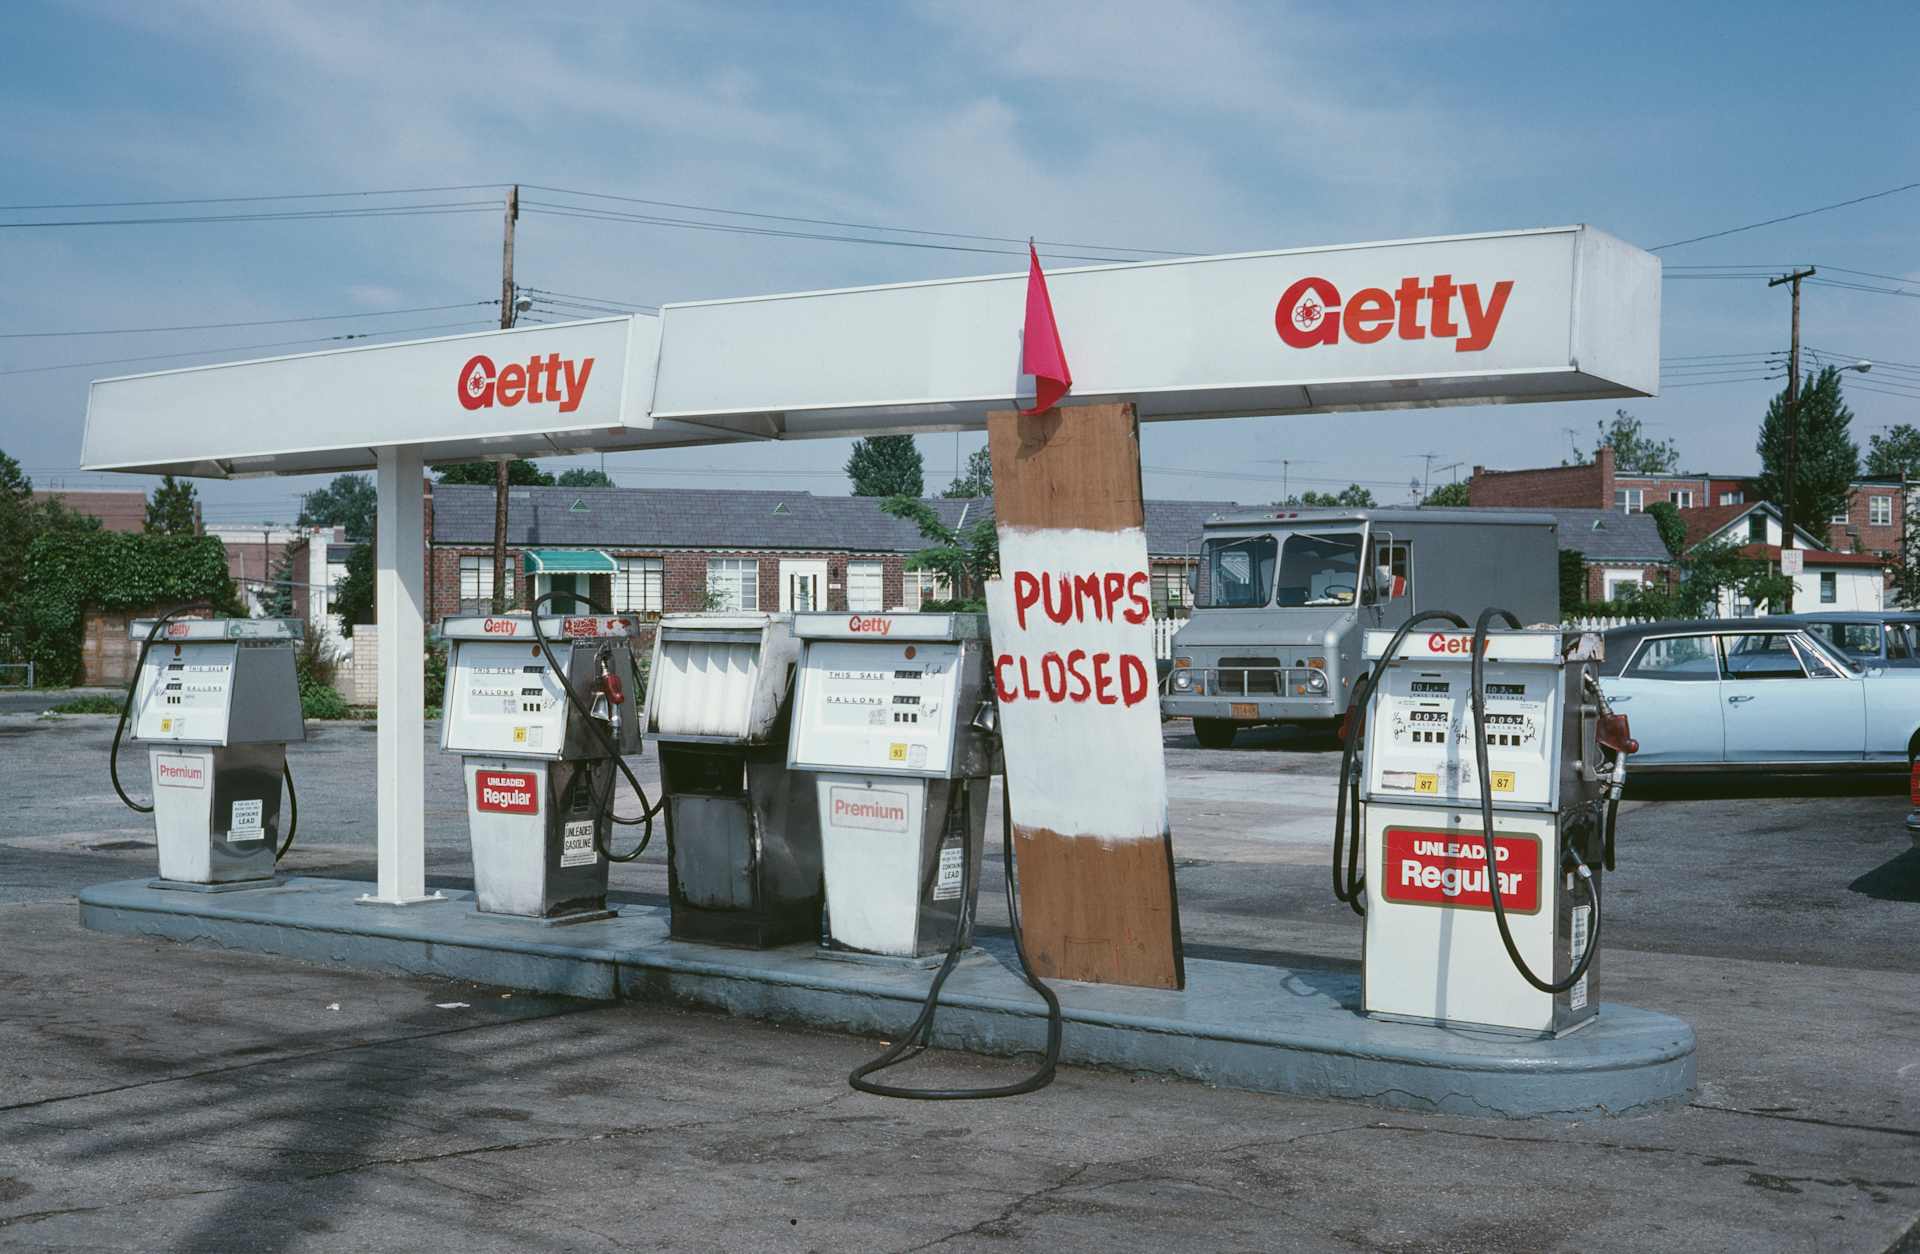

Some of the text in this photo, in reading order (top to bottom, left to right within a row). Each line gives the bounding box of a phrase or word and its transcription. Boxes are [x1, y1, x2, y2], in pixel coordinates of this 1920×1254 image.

[1275, 274, 1514, 352] Getty
[458, 353, 595, 413] Getty
[1014, 571, 1150, 631] PUMPS
[484, 618, 517, 635] Getty
[849, 614, 892, 636] Getty
[860, 672, 884, 680] SALE
[995, 649, 1148, 708] CLOSED
[472, 688, 514, 696] GALLONS
[827, 696, 883, 705] GALLONS
[160, 764, 202, 779] Premium
[487, 777, 526, 788] UNLEADED
[1420, 780, 1432, 790] 87
[1496, 778, 1509, 788] 87
[483, 787, 531, 808] Regular
[835, 799, 904, 820] Premium
[565, 825, 593, 838] UNLEADED
[565, 838, 592, 850] GASOLINE
[1414, 840, 1510, 861] UNLEADD
[944, 870, 960, 880] LEAD
